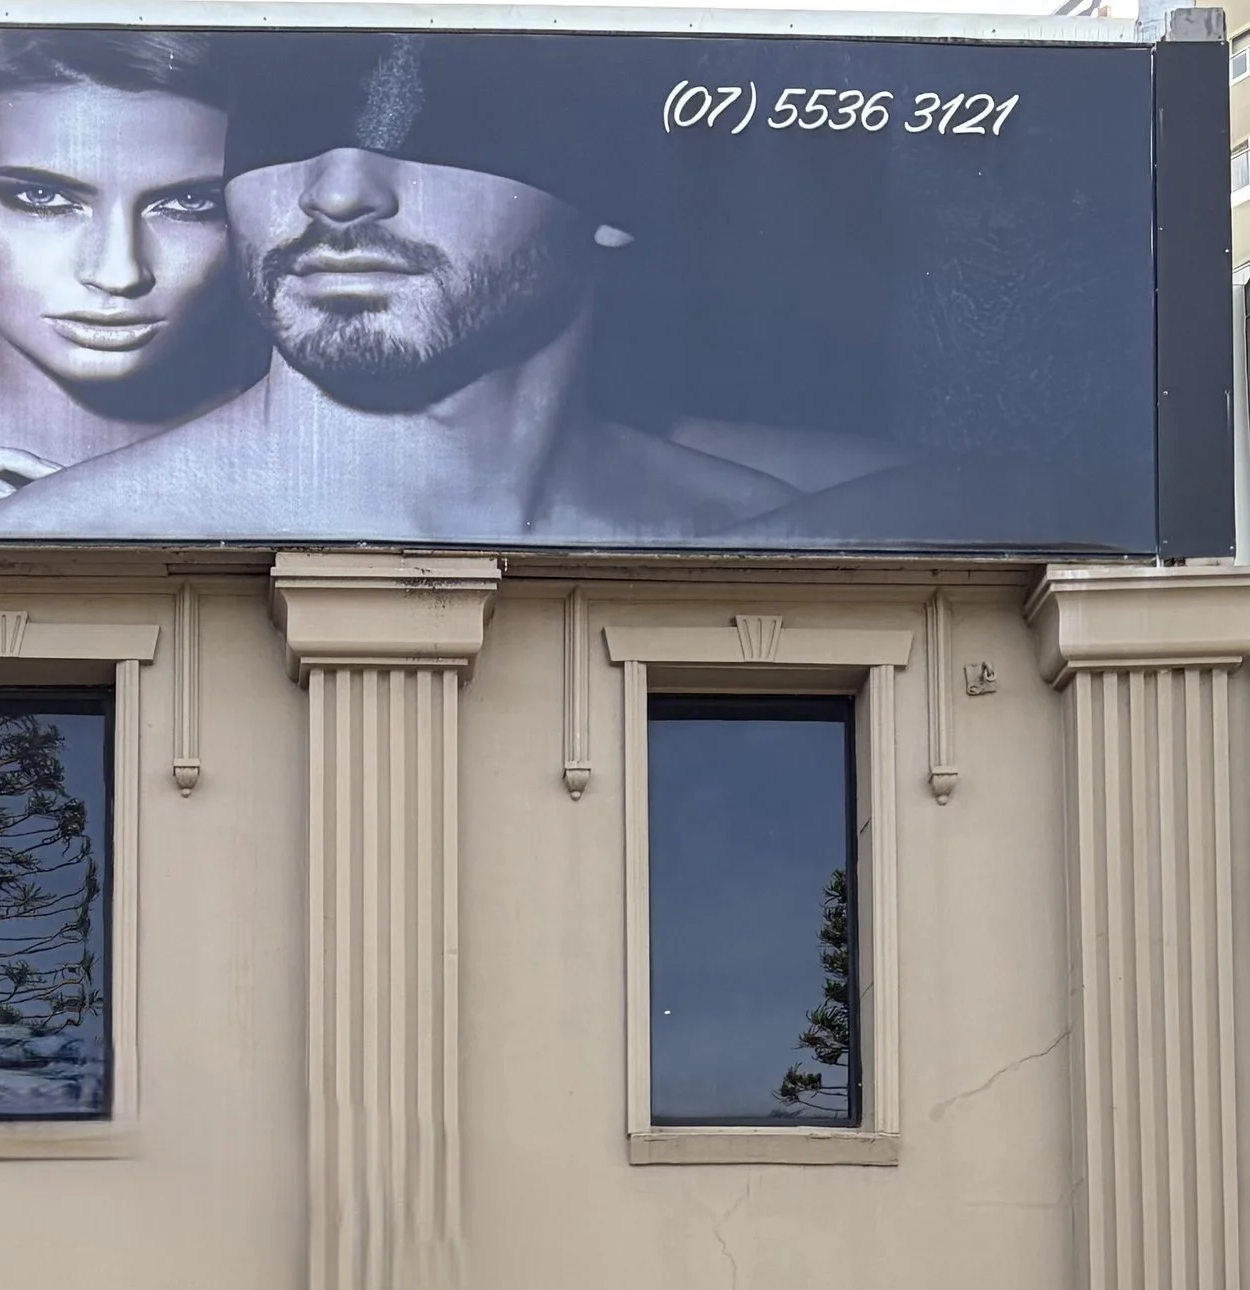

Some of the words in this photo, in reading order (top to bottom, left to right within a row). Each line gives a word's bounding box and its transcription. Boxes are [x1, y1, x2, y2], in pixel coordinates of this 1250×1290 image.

[663, 80, 757, 134] (07)
[768, 88, 894, 131] 5536
[904, 93, 1020, 135] 3121
